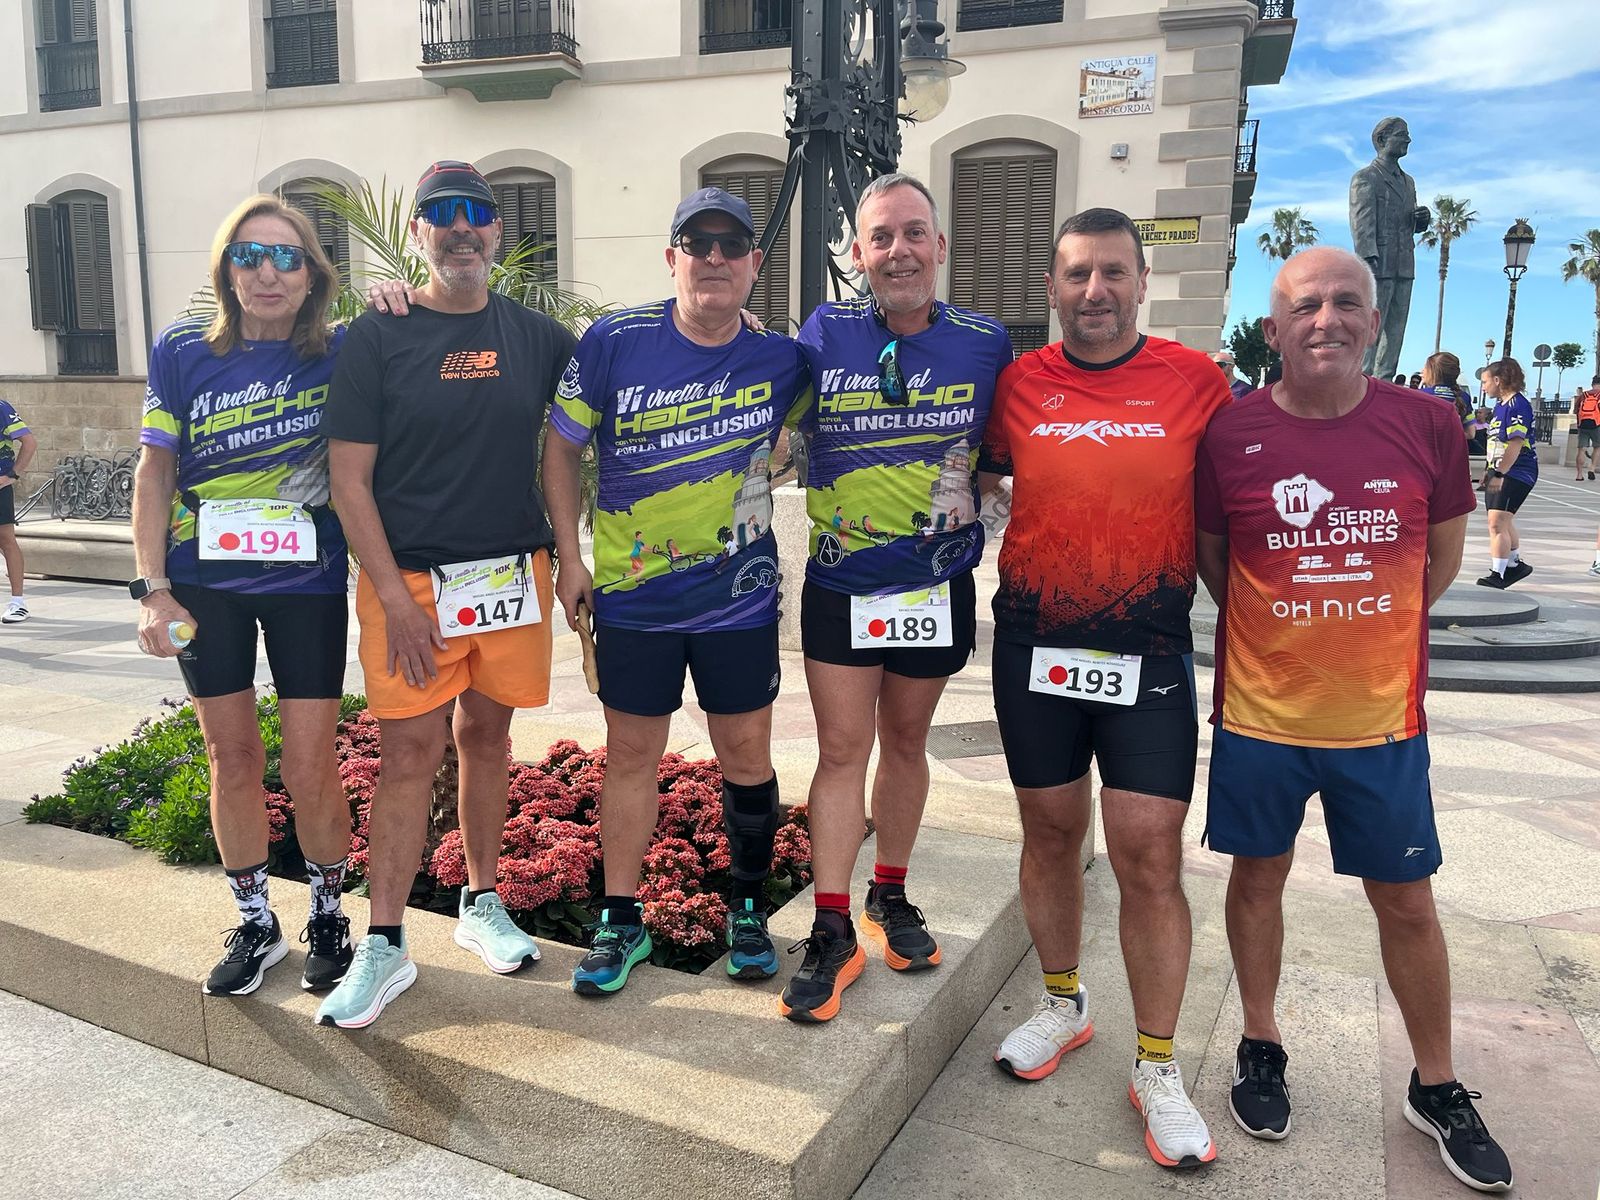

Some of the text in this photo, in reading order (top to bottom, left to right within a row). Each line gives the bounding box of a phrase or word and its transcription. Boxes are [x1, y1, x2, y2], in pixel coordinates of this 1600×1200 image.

[1084, 56, 1154, 69] ANTIGUA CALLE
[1080, 103, 1152, 116] MISERICORDIA
[1136, 223, 1156, 232] ASEO
[1141, 230, 1197, 241] ANCHEZ PRADOS
[440, 369, 500, 380] new balance
[906, 368, 932, 389] al
[215, 381, 271, 411] vuelta
[272, 374, 293, 397] al
[647, 382, 707, 409] vuelta
[708, 372, 731, 394] al
[833, 423, 851, 432] LA
[854, 406, 974, 432] INCLUSIÓN
[615, 406, 774, 456] POR LA INCLUSIÓN
[207, 444, 225, 455] LA
[1363, 481, 1398, 489] ANYERA
[1327, 508, 1399, 527] SIERRA
[241, 531, 300, 555] 194
[1266, 524, 1398, 550] BULLONES
[494, 563, 511, 576] 10K
[475, 597, 524, 627] 147
[1272, 600, 1312, 619] OH
[885, 617, 937, 641] 189
[1066, 666, 1122, 697] 193
[234, 884, 263, 899] CEUTA
